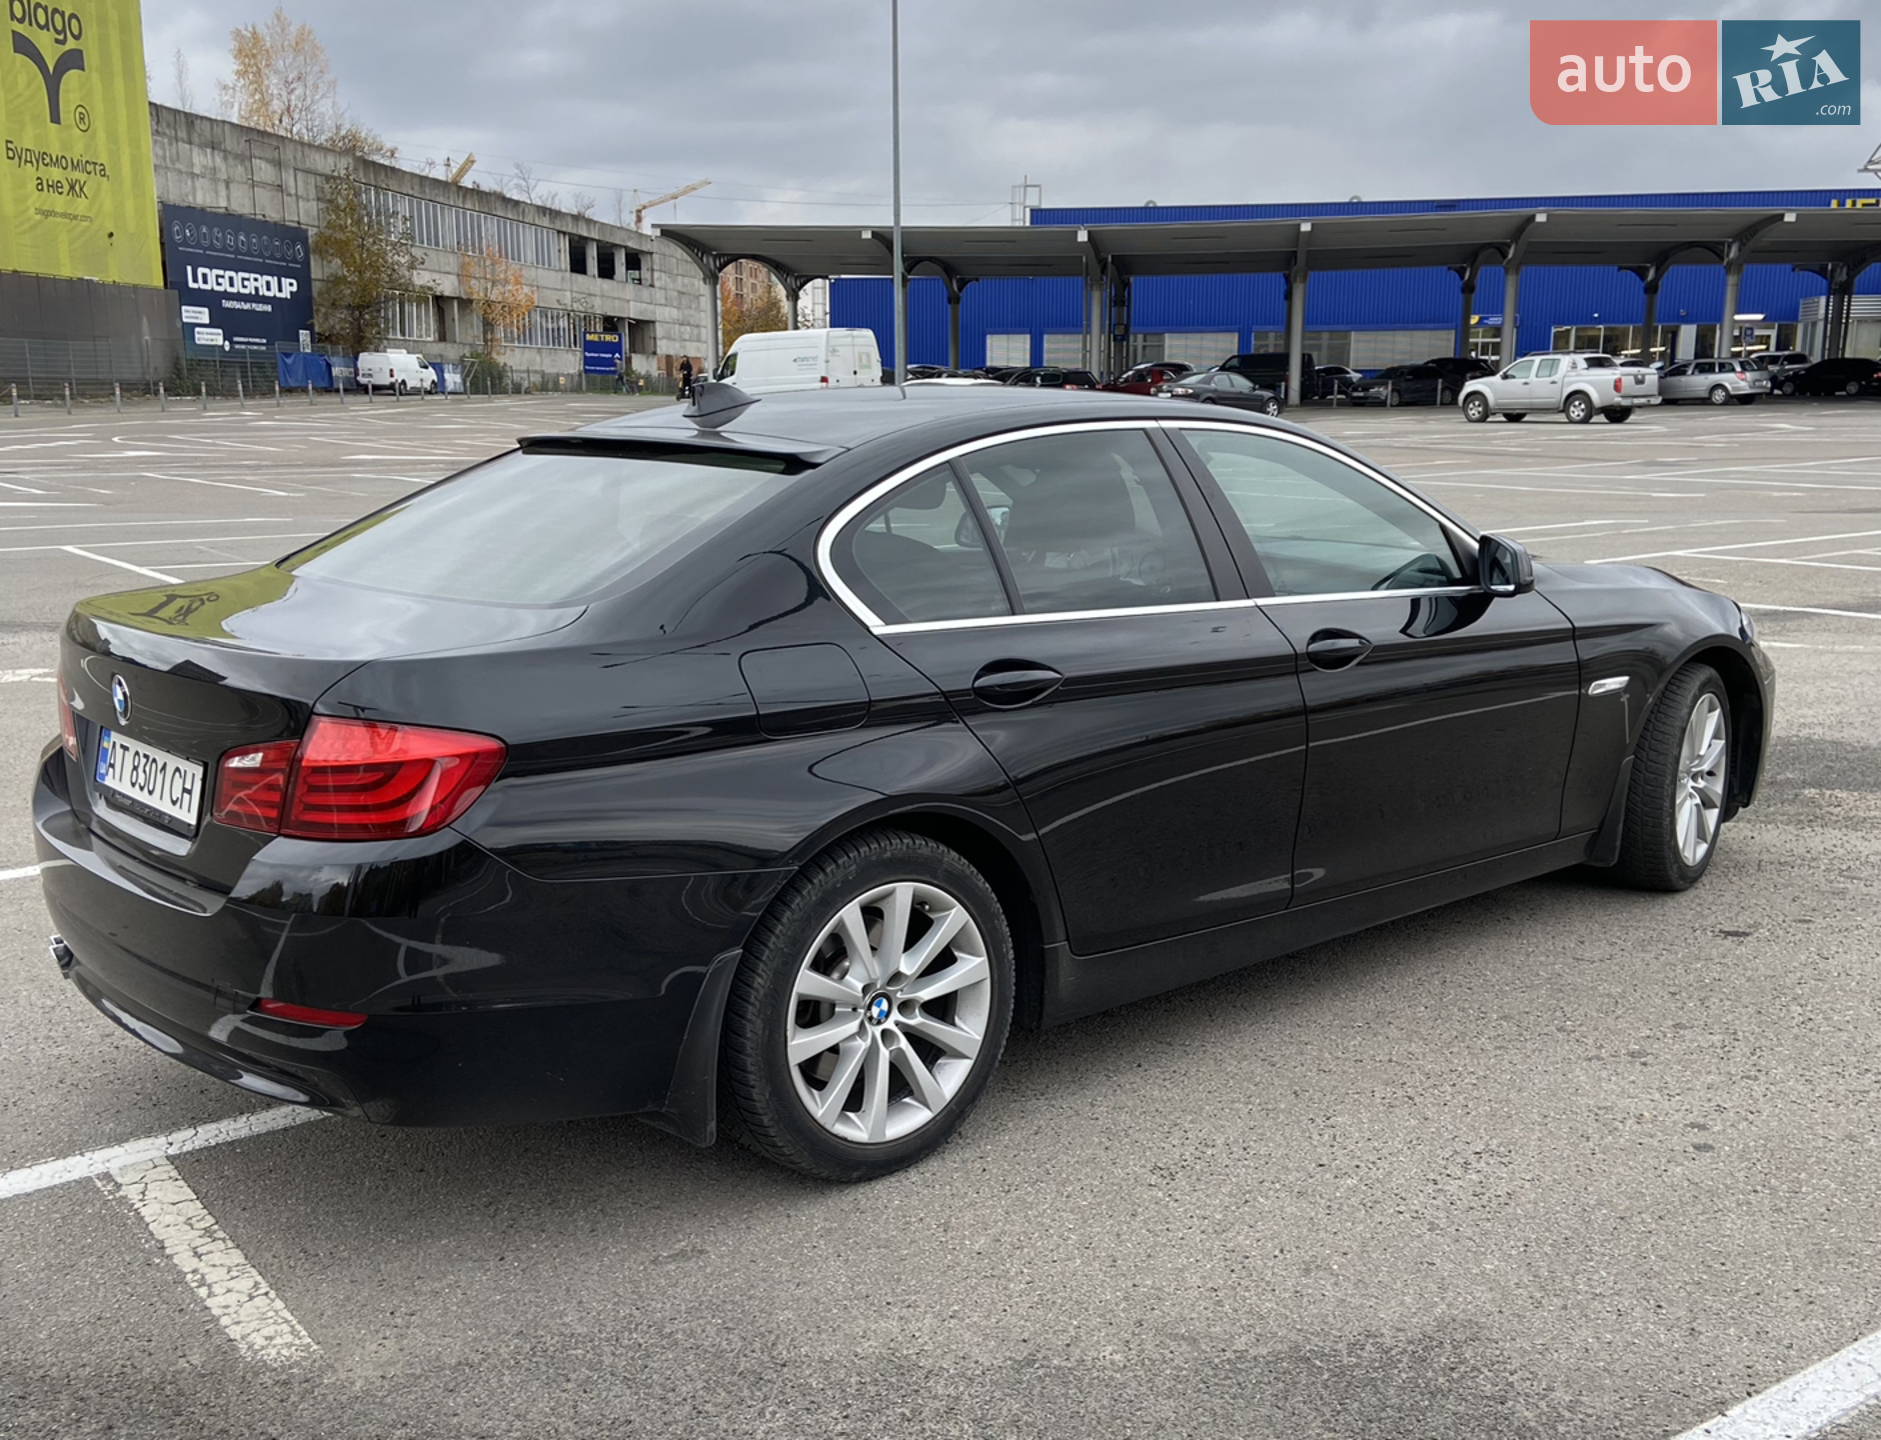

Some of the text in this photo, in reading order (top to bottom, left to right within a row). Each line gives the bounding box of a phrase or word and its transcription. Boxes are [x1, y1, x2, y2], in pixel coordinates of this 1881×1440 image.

[9, 0, 83, 46] blago
[5, 139, 110, 181] Будуємо міста,
[35, 176, 89, 200] а не ЖК
[186, 264, 298, 299] LOGOGROUP
[586, 333, 619, 342] METRO
[106, 740, 130, 783] AT
[130, 749, 168, 801] 8301
[169, 766, 196, 814] CH
